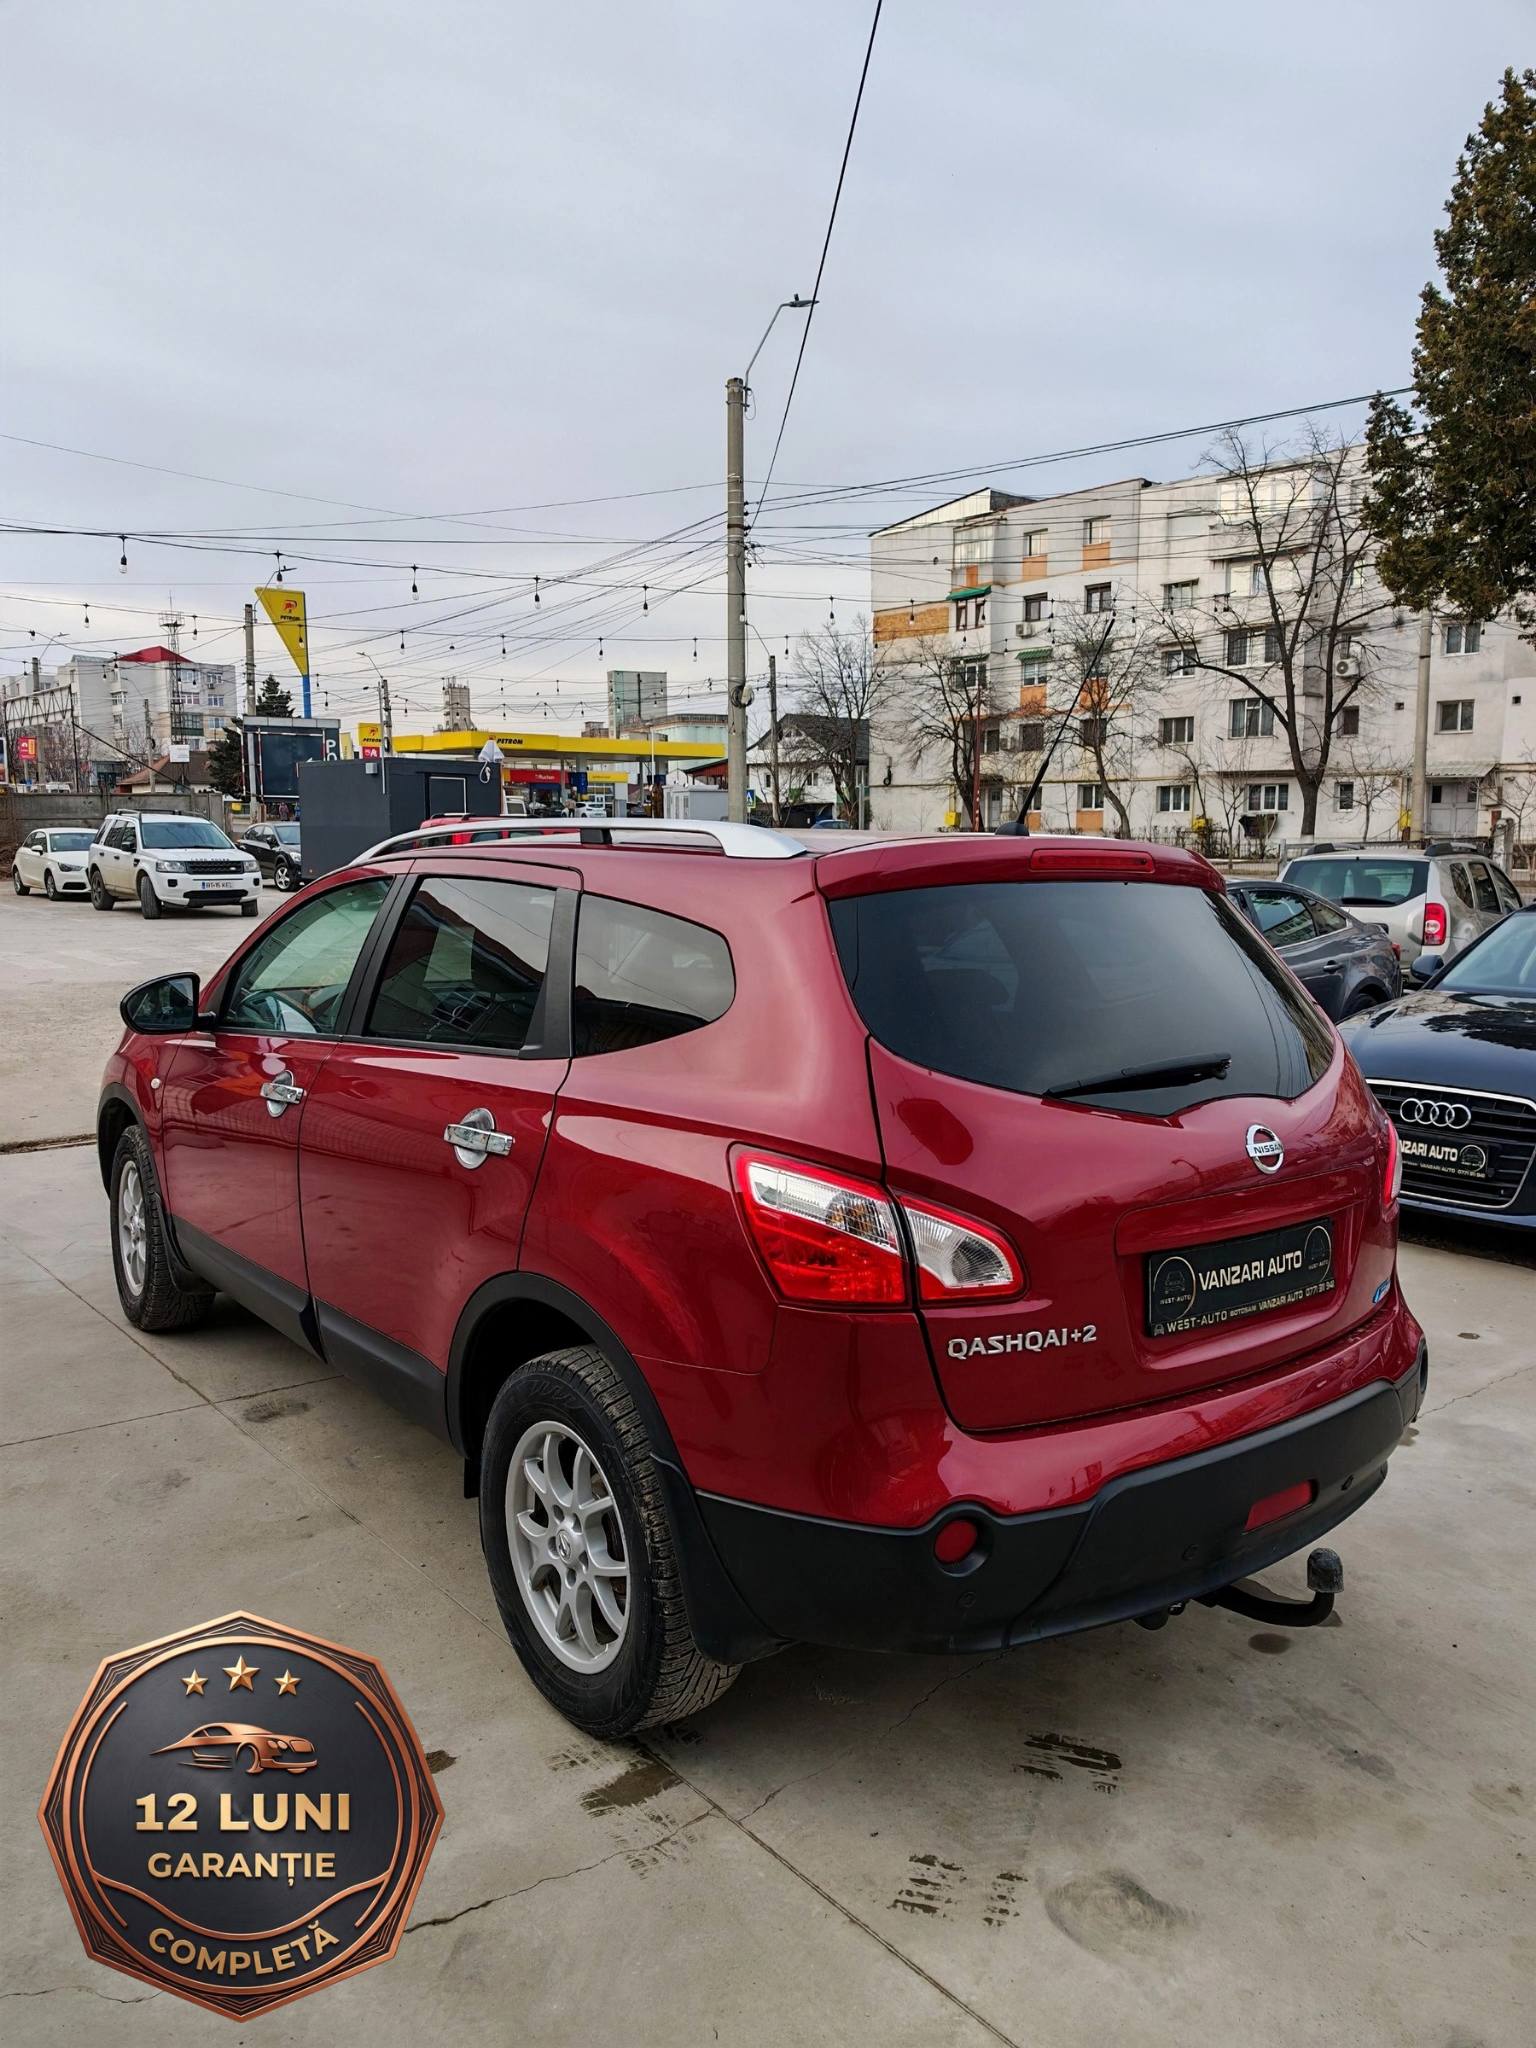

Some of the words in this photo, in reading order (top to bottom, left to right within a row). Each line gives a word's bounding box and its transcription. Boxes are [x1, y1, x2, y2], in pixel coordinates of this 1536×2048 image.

[497, 737, 523, 745] PETROM
[1253, 1143, 1282, 1154] NISSAN
[1428, 1145, 1458, 1162] AUTO
[1198, 1259, 1264, 1291] VANZARI
[1267, 1250, 1303, 1277] AUTO
[1167, 1310, 1228, 1333] WEST-AUTO
[1258, 1296, 1286, 1311] VANZARI
[1287, 1290, 1303, 1302] AUTO
[947, 1324, 1097, 1360] QASHQAI+2
